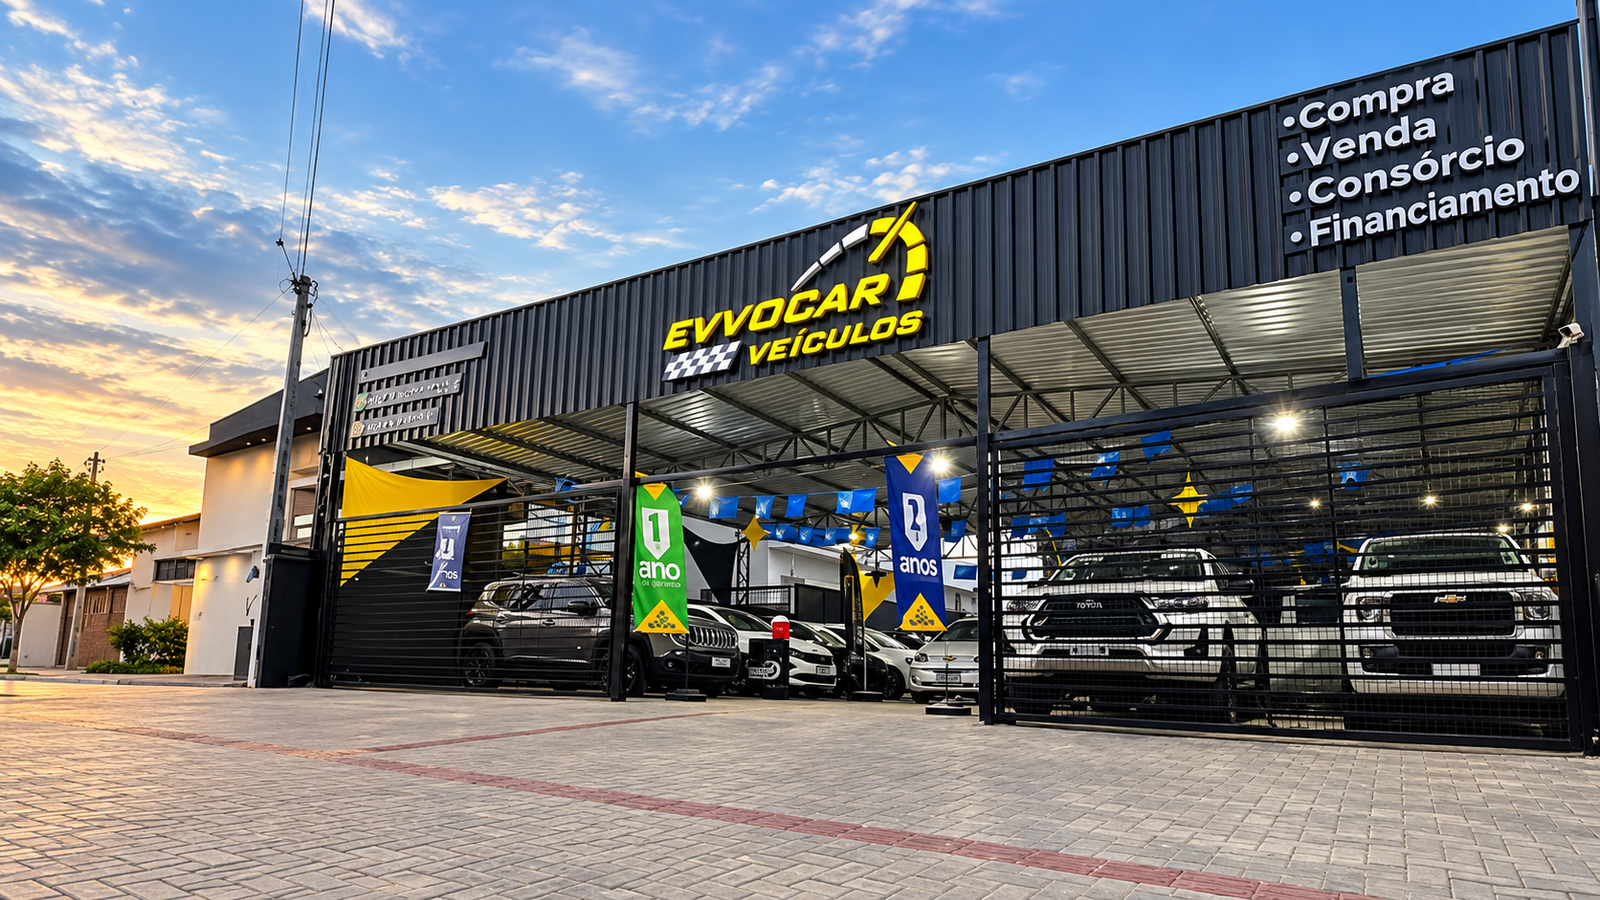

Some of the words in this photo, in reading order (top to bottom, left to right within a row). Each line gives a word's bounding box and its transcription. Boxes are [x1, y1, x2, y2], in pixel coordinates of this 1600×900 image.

[1299, 72, 1455, 129] Compra
[1301, 115, 1436, 166] Venda
[1307, 135, 1525, 204] Consórcio
[1310, 168, 1580, 247] Financiamento
[662, 273, 891, 351] EVVOCAR
[749, 310, 924, 365] VEÍCULOS
[648, 512, 661, 542] 1
[638, 560, 681, 580] ano
[899, 556, 938, 577] anos
